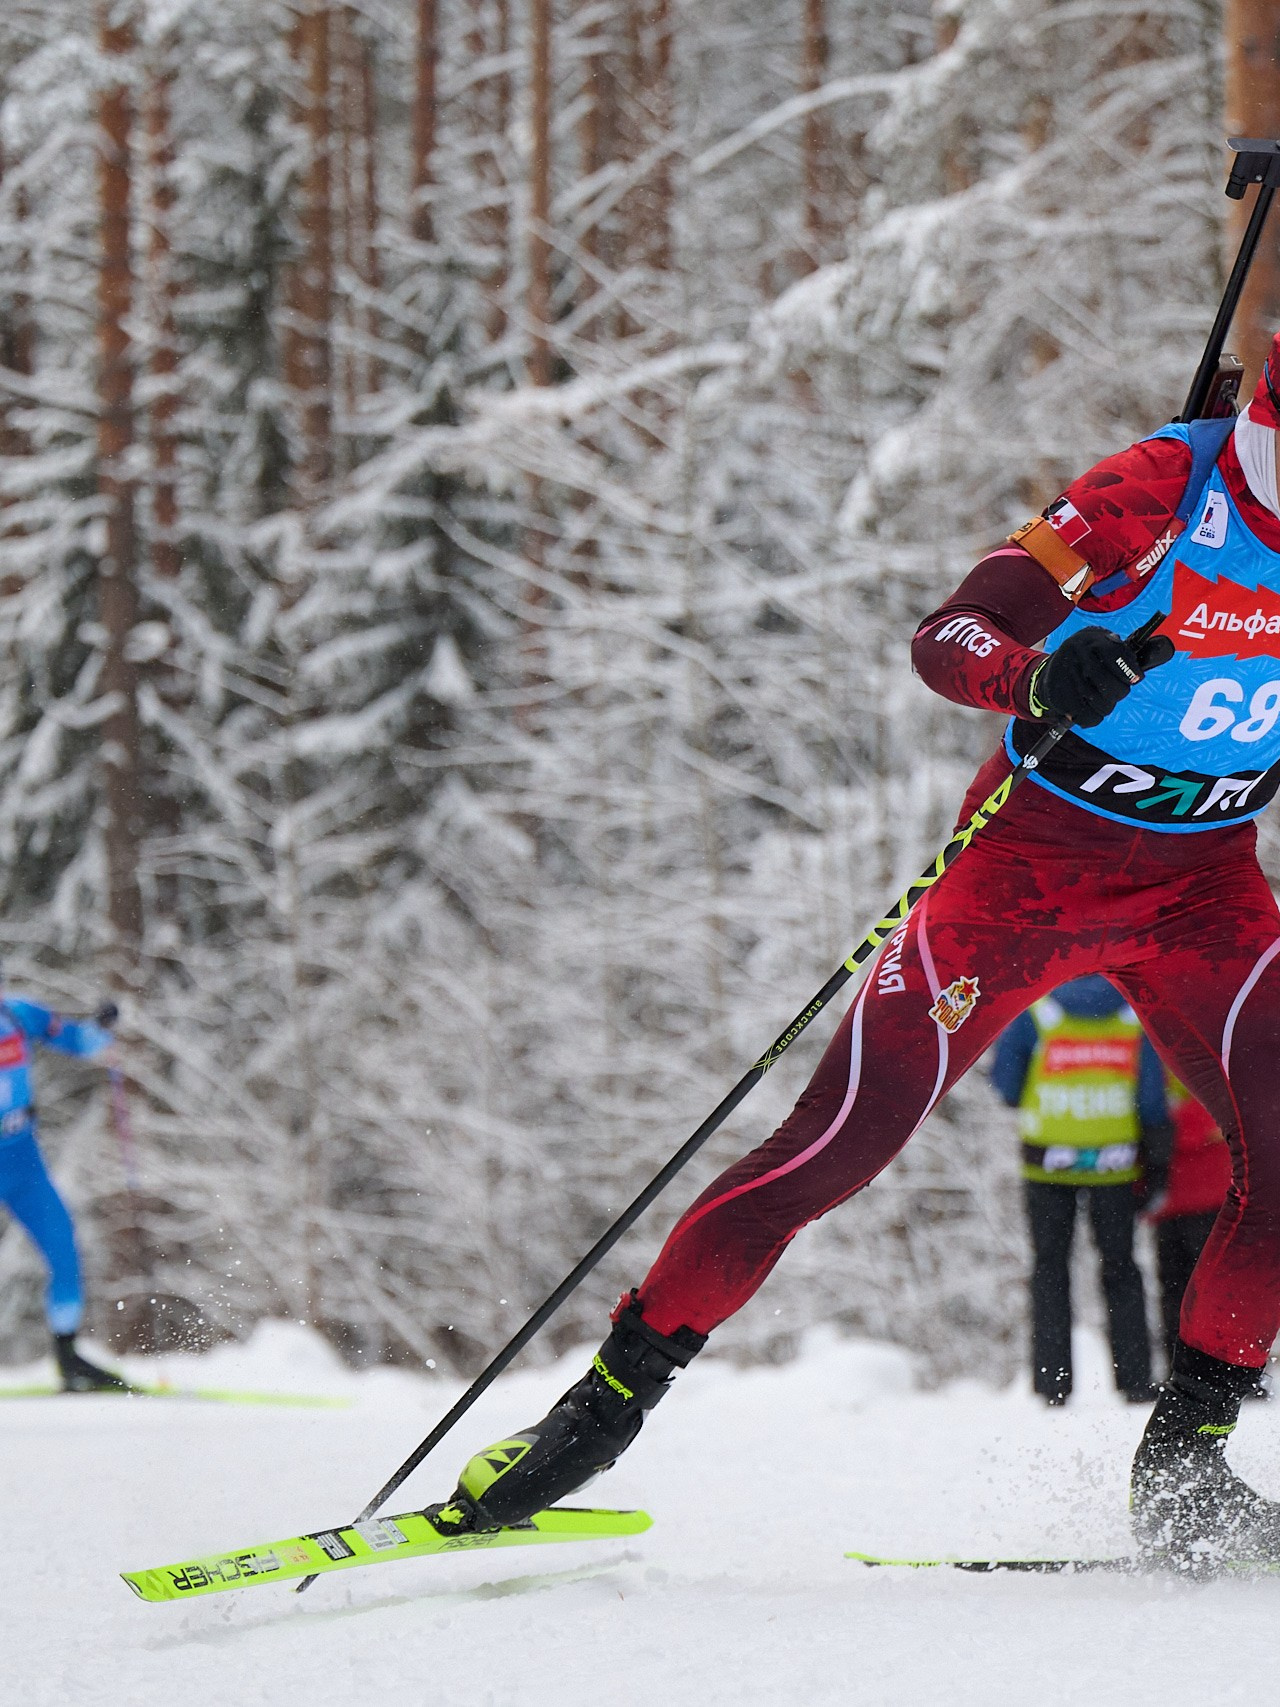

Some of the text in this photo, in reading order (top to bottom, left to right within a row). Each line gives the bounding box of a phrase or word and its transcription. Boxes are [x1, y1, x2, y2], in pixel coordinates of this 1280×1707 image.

[775, 999, 823, 1053] BLACKCODE
[593, 1354, 634, 1400] SCHER
[1196, 1422, 1237, 1435] FISC
